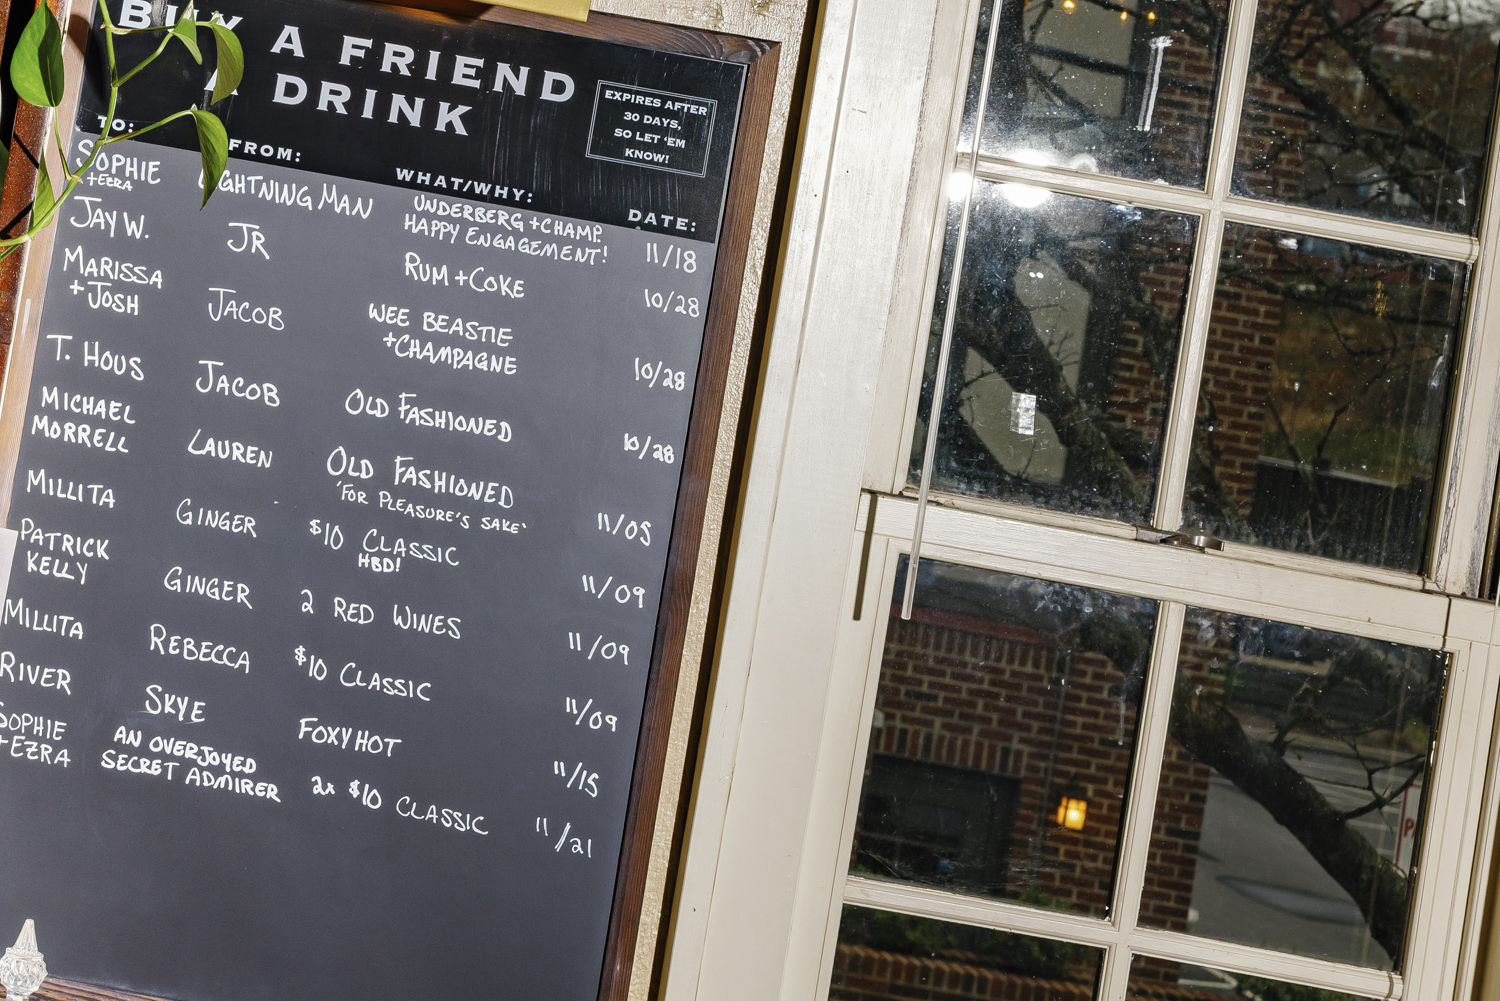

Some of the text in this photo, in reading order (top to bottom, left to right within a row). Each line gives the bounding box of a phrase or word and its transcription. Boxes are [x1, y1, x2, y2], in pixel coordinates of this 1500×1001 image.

[270, 25, 304, 58] A
[338, 35, 575, 102] FRIEND
[272, 73, 473, 136] DRINK
[604, 89, 707, 116] EXPIRES AFTER
[623, 111, 681, 131] 30 DAYS,
[97, 115, 134, 133] TO:
[614, 127, 632, 140] SO
[635, 131, 660, 144] LET
[76, 139, 161, 185] SOPHIE
[228, 139, 301, 163] FROM:
[624, 148, 669, 164] KNOW!
[198, 169, 373, 219] GHTNING MAN
[396, 167, 533, 203] WHAT/WHY:
[70, 196, 149, 239] JAY W.
[413, 195, 524, 231] UNDERBERG
[628, 209, 697, 232] DATE:
[227, 222, 270, 260] JR
[404, 213, 608, 264] HAPPY ENGAGEMENT!
[646, 243, 697, 273] 11/18
[63, 246, 163, 289] MARISSA
[404, 251, 449, 286] RUM
[208, 287, 285, 330] JACOB
[645, 289, 700, 318] 10/28
[368, 303, 513, 347] WEE BEASTIE
[47, 334, 144, 381] T. HOUS
[634, 357, 686, 391] 10/28
[195, 360, 280, 407] JACOB
[41, 386, 136, 424] MICHAEL
[345, 388, 512, 443] OLD FASHIONED
[31, 414, 128, 453] MORRELL
[187, 428, 273, 468] LAUREN
[624, 433, 675, 464] 10/28
[26, 468, 116, 509] MILLITA
[326, 446, 514, 509] OLD FASHIONED
[176, 498, 257, 538] GINGER
[379, 491, 470, 529] PLEASURE'S
[598, 512, 652, 546] 11/05
[20, 518, 110, 560] PATRICK
[309, 519, 460, 566] $10 CLASSIC
[27, 550, 88, 585] KELLY
[358, 553, 401, 574] HBD!
[164, 566, 253, 609] GINGER
[582, 574, 645, 608] 11/09
[4, 598, 84, 640] MILLITA
[300, 589, 462, 639] 2 RED WINES
[149, 623, 250, 674] REBECCA
[568, 631, 629, 666] 11/09
[0, 651, 71, 695] RIVER
[294, 645, 432, 701] $10 CLASSIC
[145, 684, 206, 723] SKYE
[565, 697, 617, 732] 11/09
[113, 725, 257, 774] AN OVERJOYED
[100, 750, 281, 803] SECRET ADMIRER
[554, 761, 599, 798] 11/15
[349, 779, 382, 809] $10
[396, 796, 489, 835] CLASSIC
[536, 817, 592, 858] 11/21
